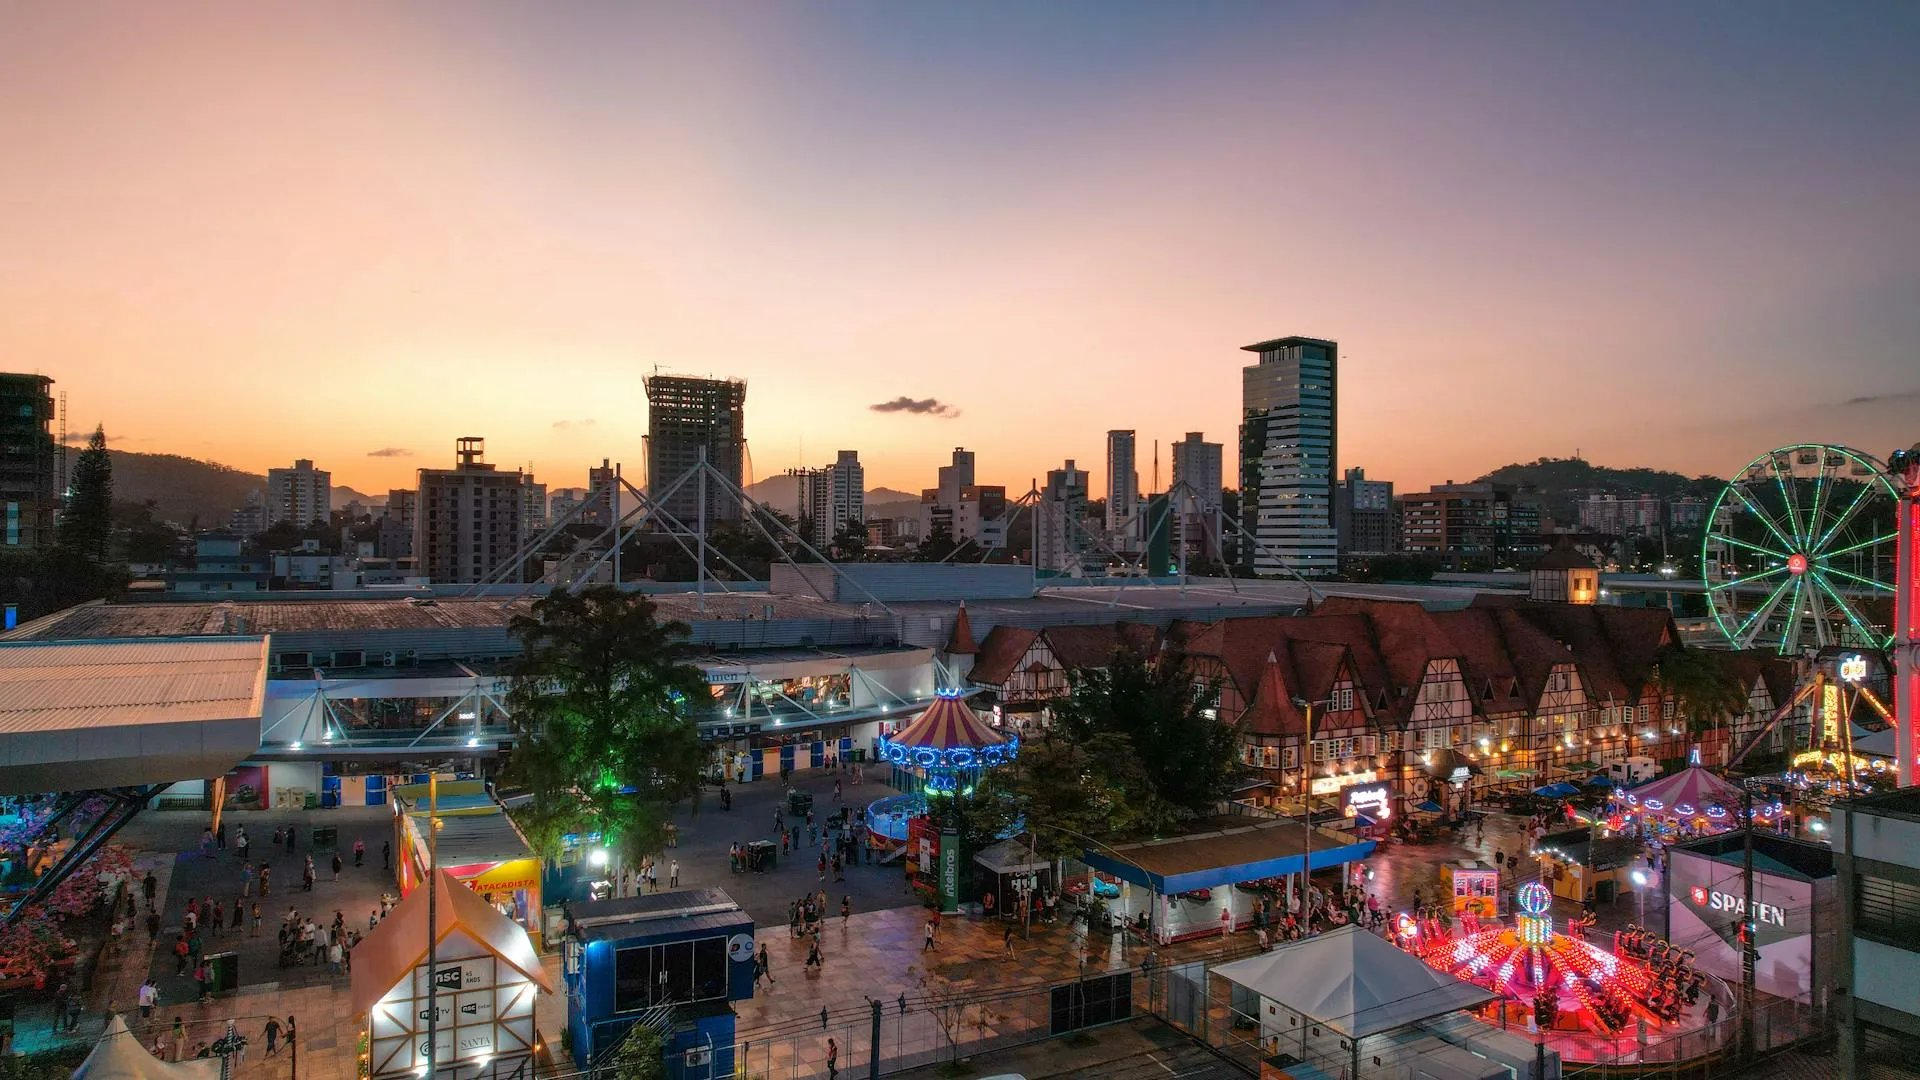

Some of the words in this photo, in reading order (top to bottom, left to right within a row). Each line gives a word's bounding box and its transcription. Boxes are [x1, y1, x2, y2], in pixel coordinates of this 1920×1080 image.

[944, 849, 955, 897] intelbras
[476, 880, 535, 891] ATACADISTA
[1710, 891, 1785, 927] SPATEN
[436, 971, 460, 983] nsc
[465, 976, 481, 984] ANOS
[460, 1036, 491, 1048] SANTA
